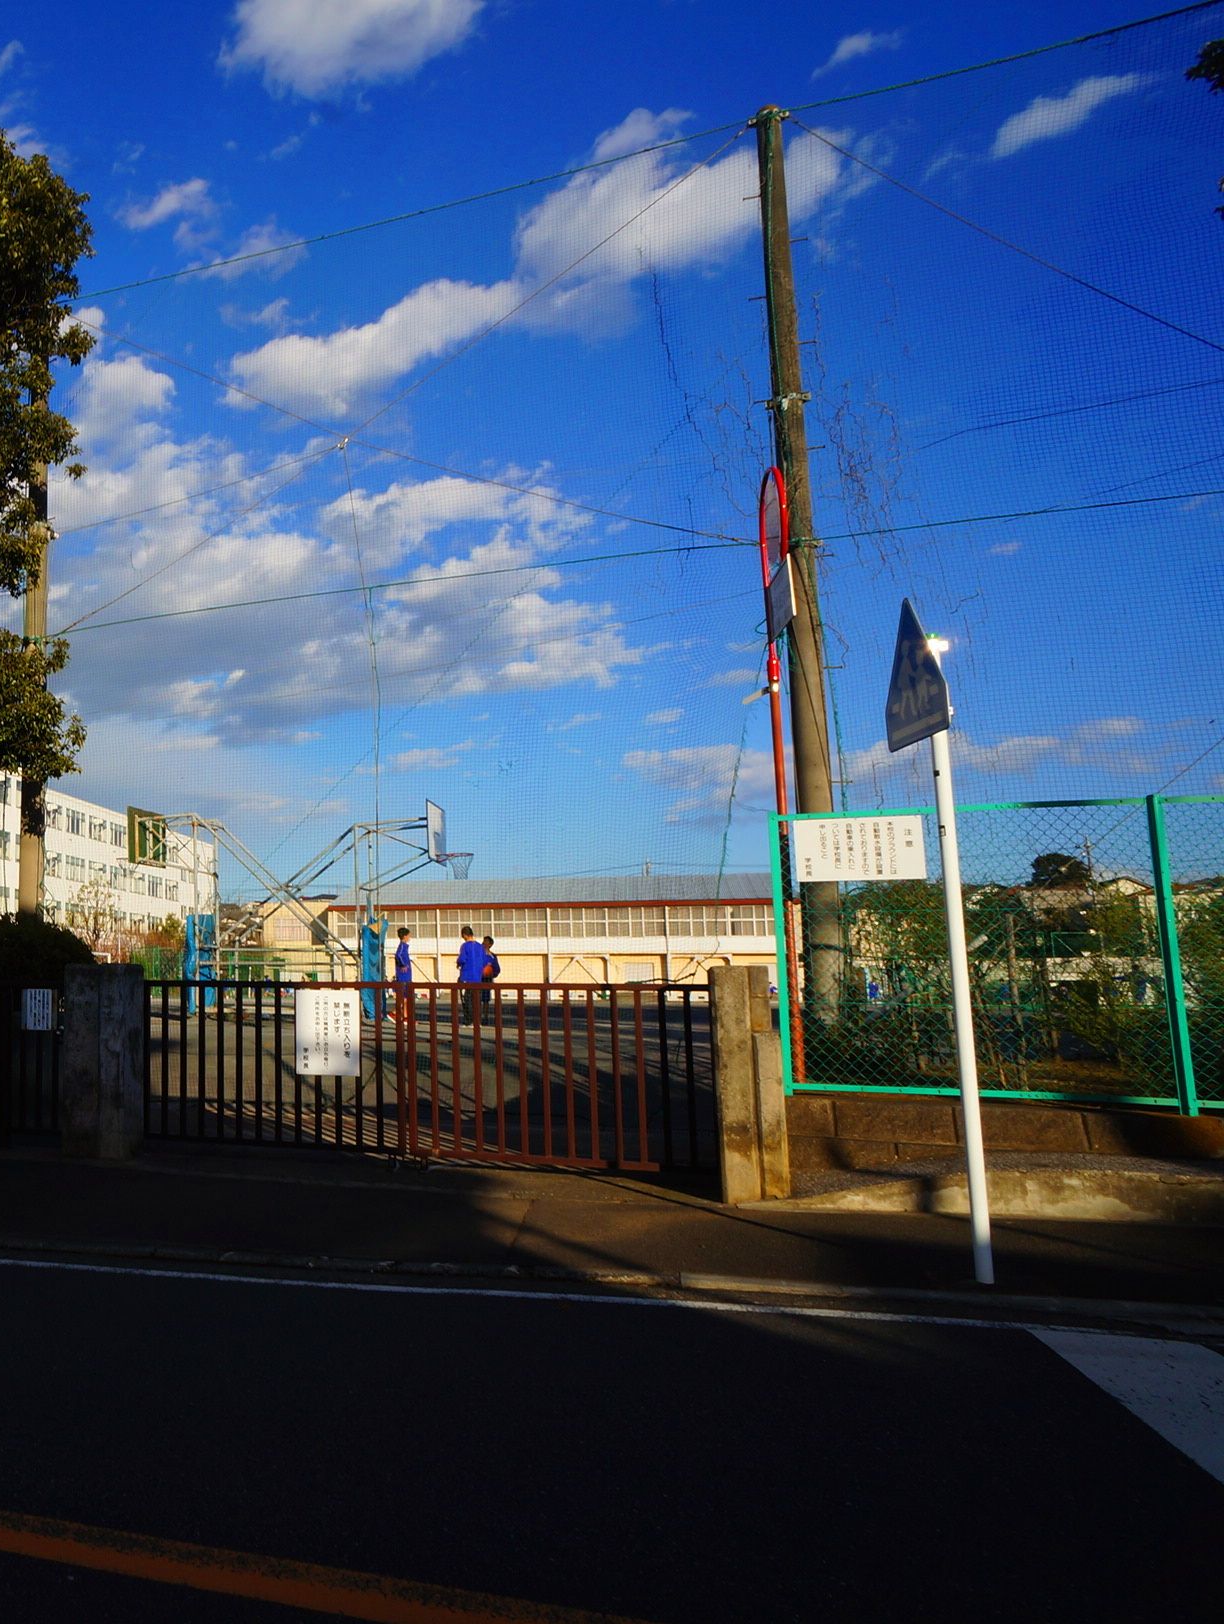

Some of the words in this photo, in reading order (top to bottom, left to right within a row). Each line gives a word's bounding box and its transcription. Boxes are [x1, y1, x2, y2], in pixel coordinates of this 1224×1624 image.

[804, 857, 813, 877] 学校長
[343, 1002, 351, 1058] 無断立ち入りを
